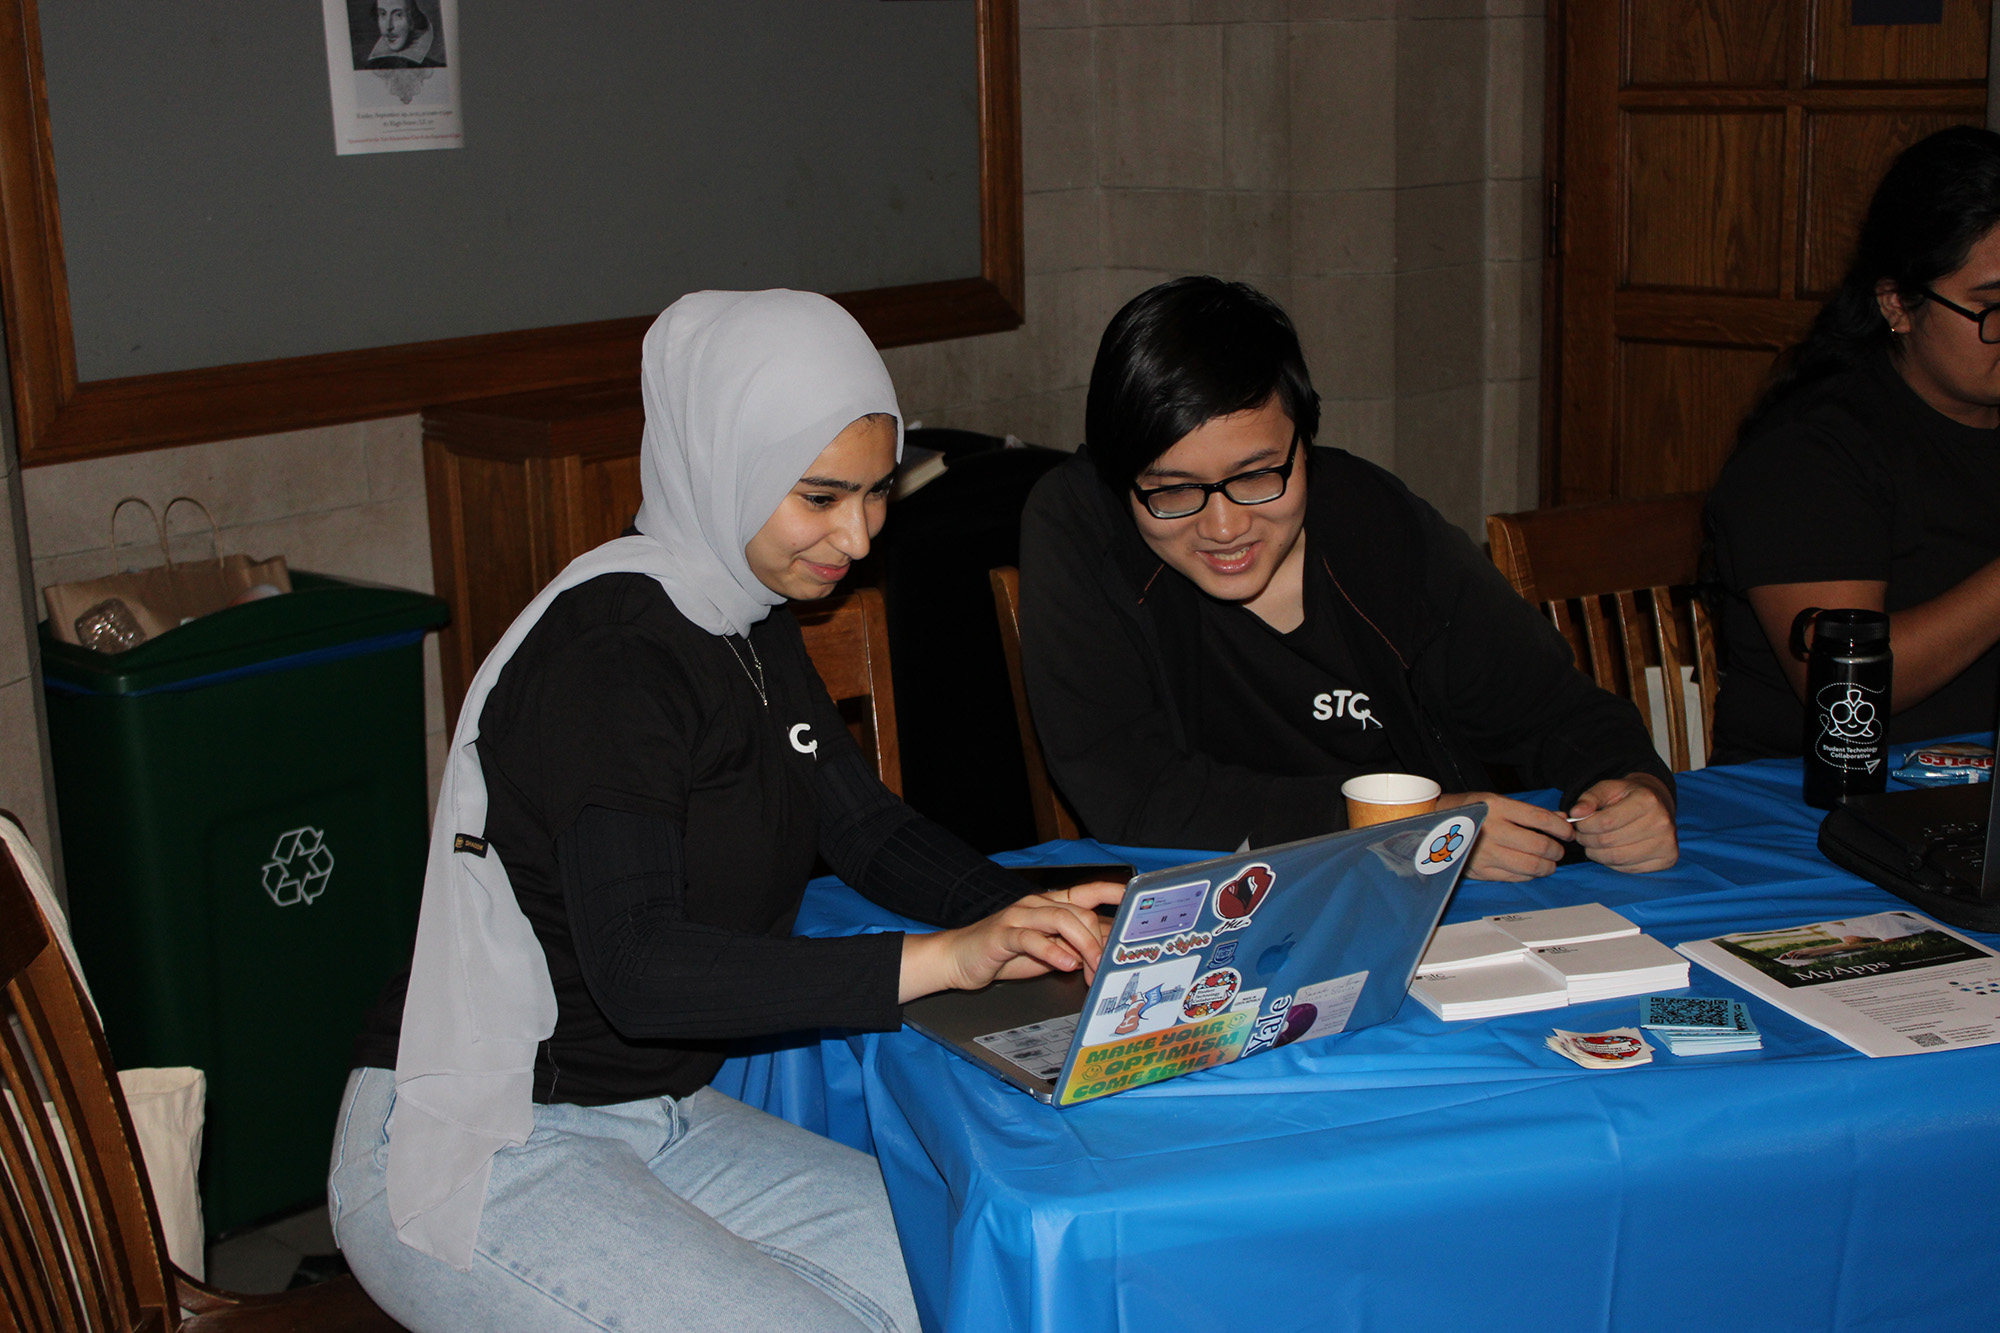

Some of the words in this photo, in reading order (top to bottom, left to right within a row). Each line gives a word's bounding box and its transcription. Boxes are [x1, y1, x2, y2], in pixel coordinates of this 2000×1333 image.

[787, 723, 818, 757] C
[1822, 744, 1846, 754] Student
[1846, 746, 1879, 755] Technology
[1830, 752, 1871, 760] Collaborative
[1116, 947, 1160, 962] harry
[1165, 935, 1210, 954] styles
[1793, 960, 1891, 982] MyApps
[1085, 1037, 1157, 1064] MAKE
[1159, 1020, 1225, 1047] YOUR
[1245, 999, 1291, 1057] Yale
[1104, 1031, 1239, 1076] OPTIMISM
[1072, 1070, 1144, 1099] COME
